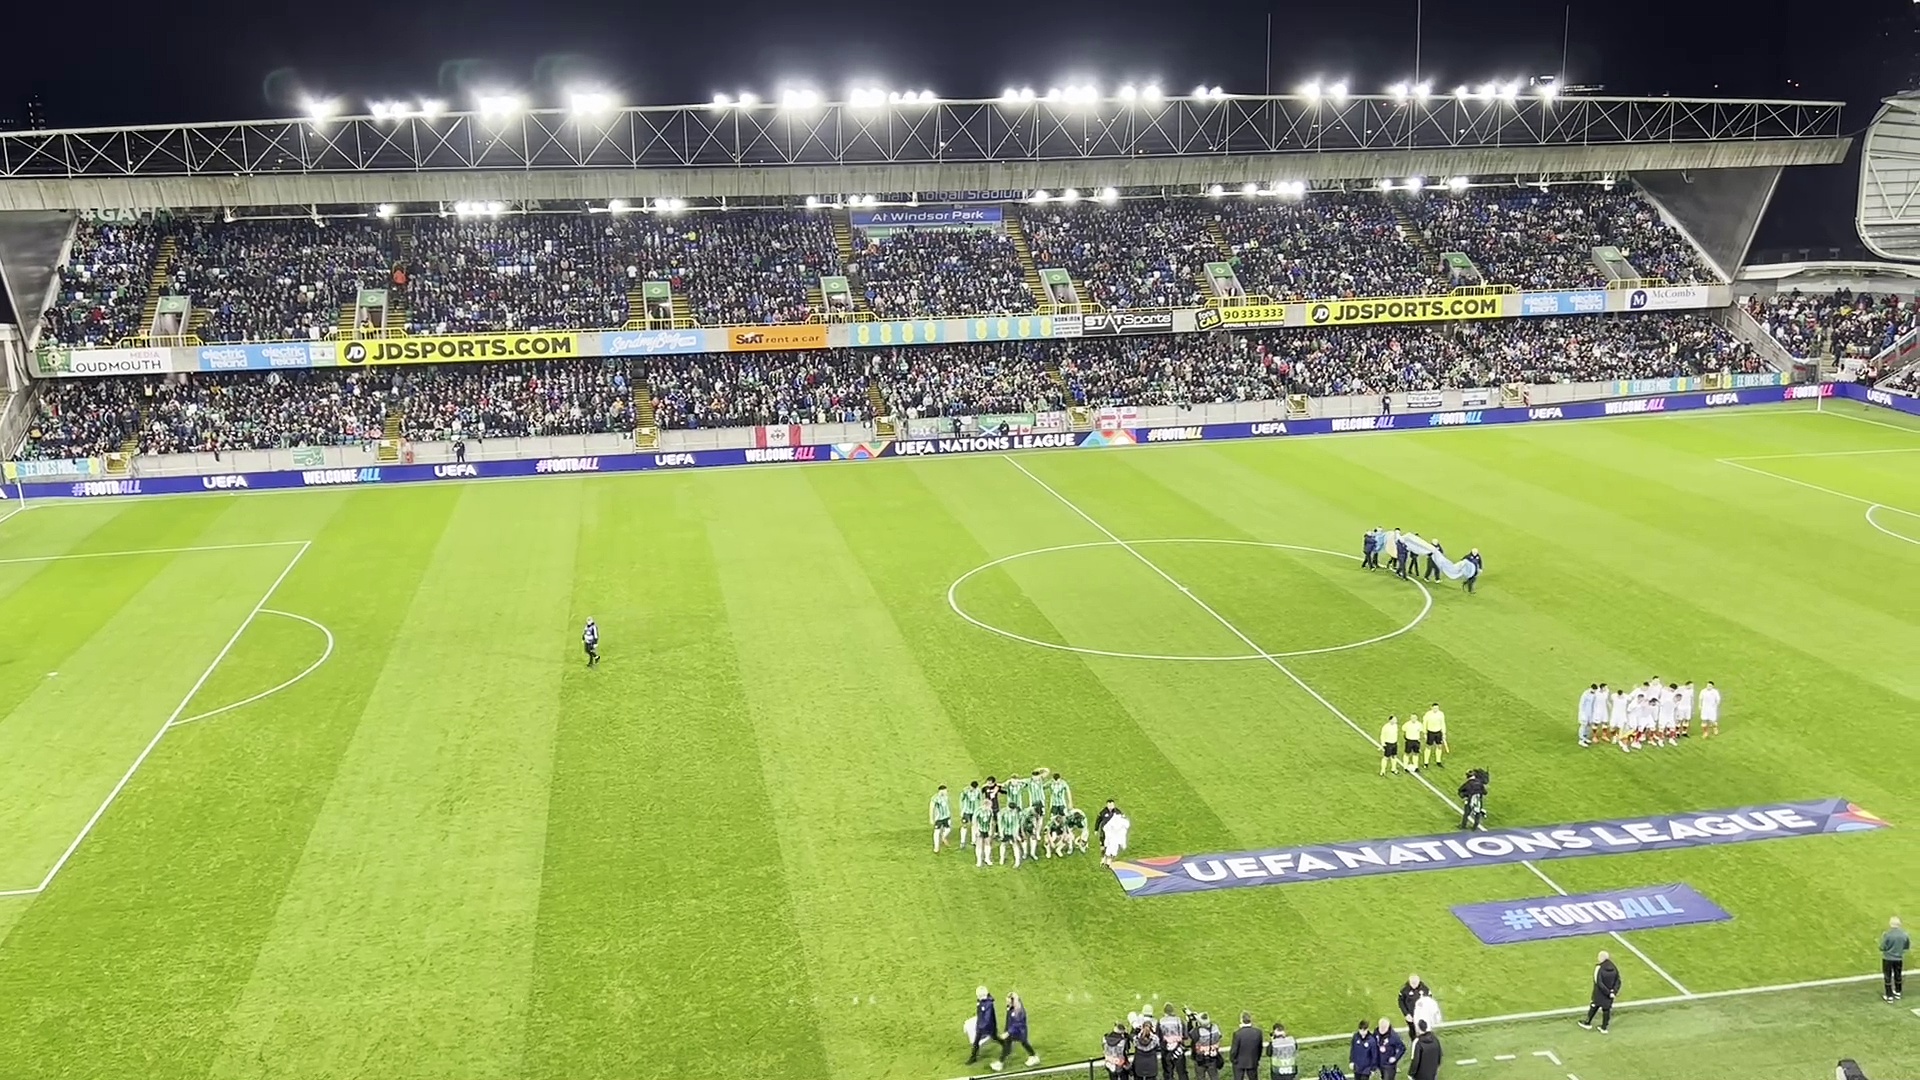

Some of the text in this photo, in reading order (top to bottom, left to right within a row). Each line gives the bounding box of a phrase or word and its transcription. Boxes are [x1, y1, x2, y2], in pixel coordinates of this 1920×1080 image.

[872, 210, 984, 222] At Windsor Park
[1652, 288, 1696, 298] McComb's
[1224, 308, 1283, 319] 90 333 333
[1334, 299, 1496, 321] JDSPORTS.COM
[372, 337, 571, 360] JDSPORTS.COM
[1705, 393, 1739, 405] UEFA
[1866, 390, 1892, 405] UEFA
[1429, 411, 1482, 426] #FOOTBALL
[1529, 408, 1563, 420] UEFA
[1251, 422, 1287, 434] UEFA
[894, 433, 1075, 456] UEFA NATIONS LEAGUE
[535, 457, 599, 473] #FOOTBALL
[654, 453, 695, 466] UEFA
[433, 464, 477, 477] UEFA
[72, 480, 142, 497] #FOOTBALL
[202, 475, 248, 488] UEFA
[1182, 808, 1818, 883] UEFA NATIONS LEAGUE
[1501, 894, 1685, 931] #FOOTBALL
